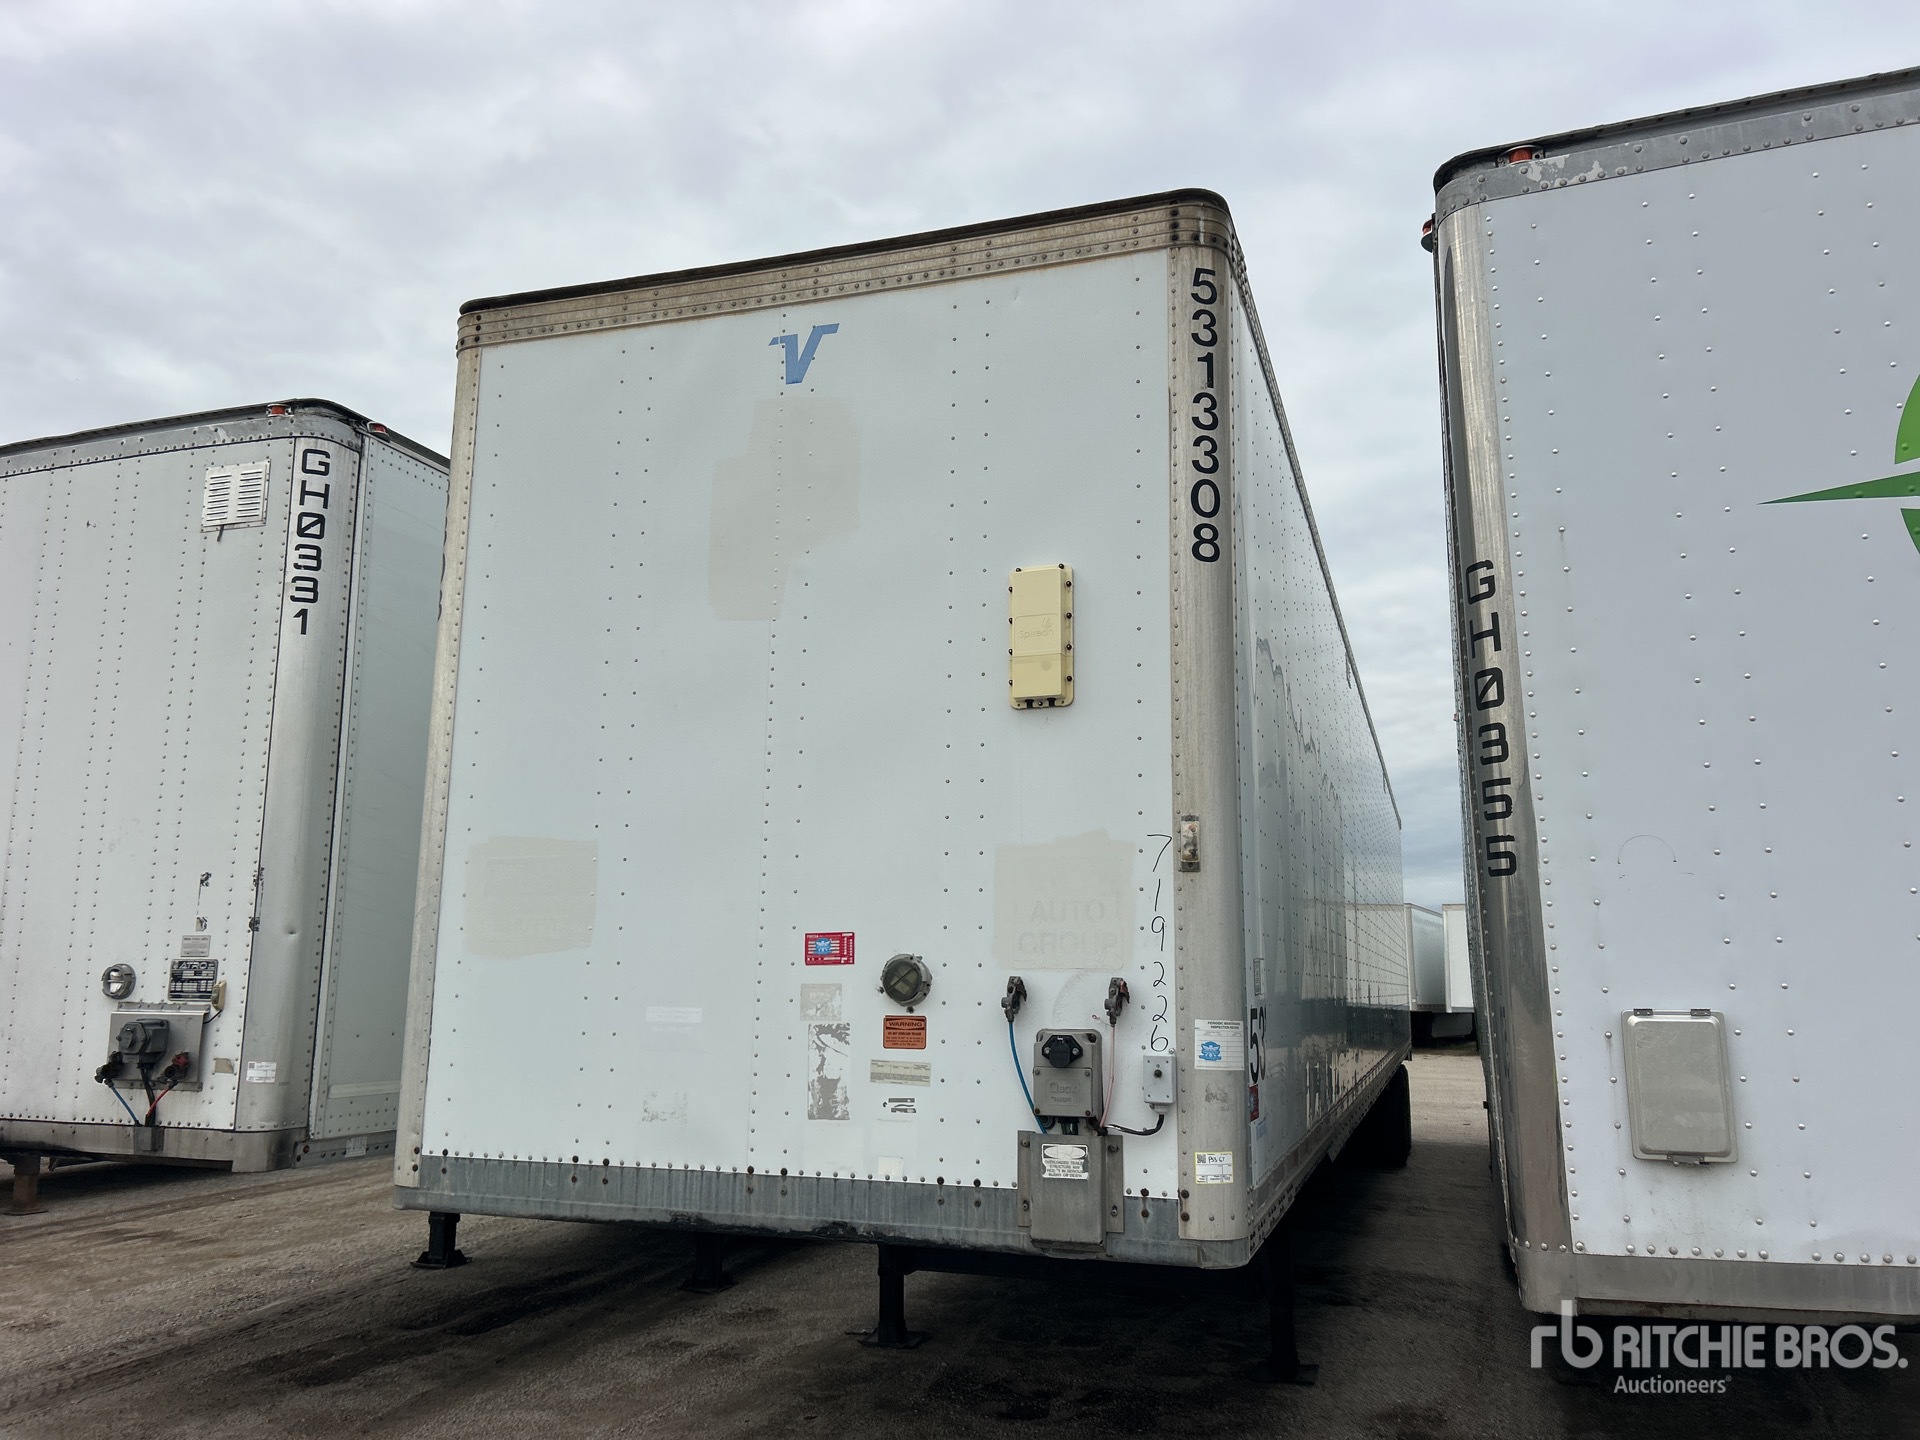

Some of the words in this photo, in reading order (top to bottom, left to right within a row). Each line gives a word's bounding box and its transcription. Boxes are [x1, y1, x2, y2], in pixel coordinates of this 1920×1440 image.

[1190, 267, 1220, 563] 5313308
[290, 448, 331, 635] GH0331
[1466, 559, 1517, 877] GH0355
[1030, 899, 1105, 923] AUTO
[1147, 834, 1173, 1053] 719226
